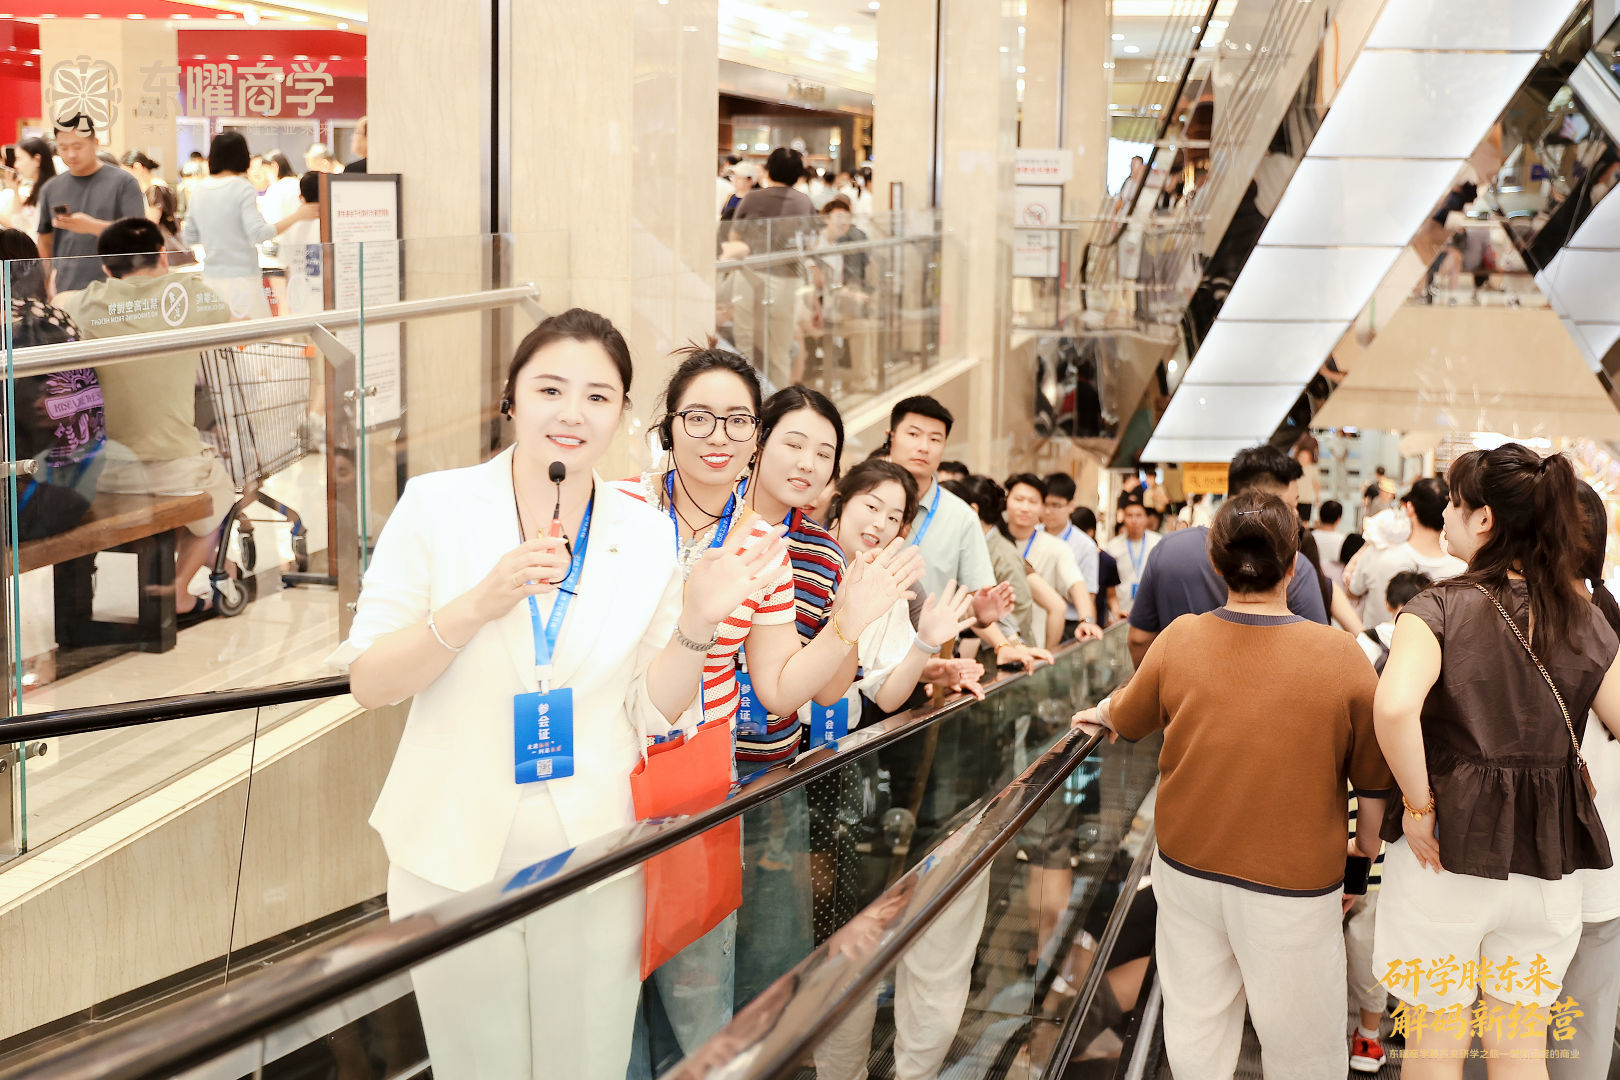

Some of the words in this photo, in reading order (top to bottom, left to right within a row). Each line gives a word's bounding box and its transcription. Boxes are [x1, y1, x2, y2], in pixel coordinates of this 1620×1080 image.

[537, 702, 551, 740] 参会证
[740, 683, 752, 721] 参会证
[824, 709, 835, 741] 参会证
